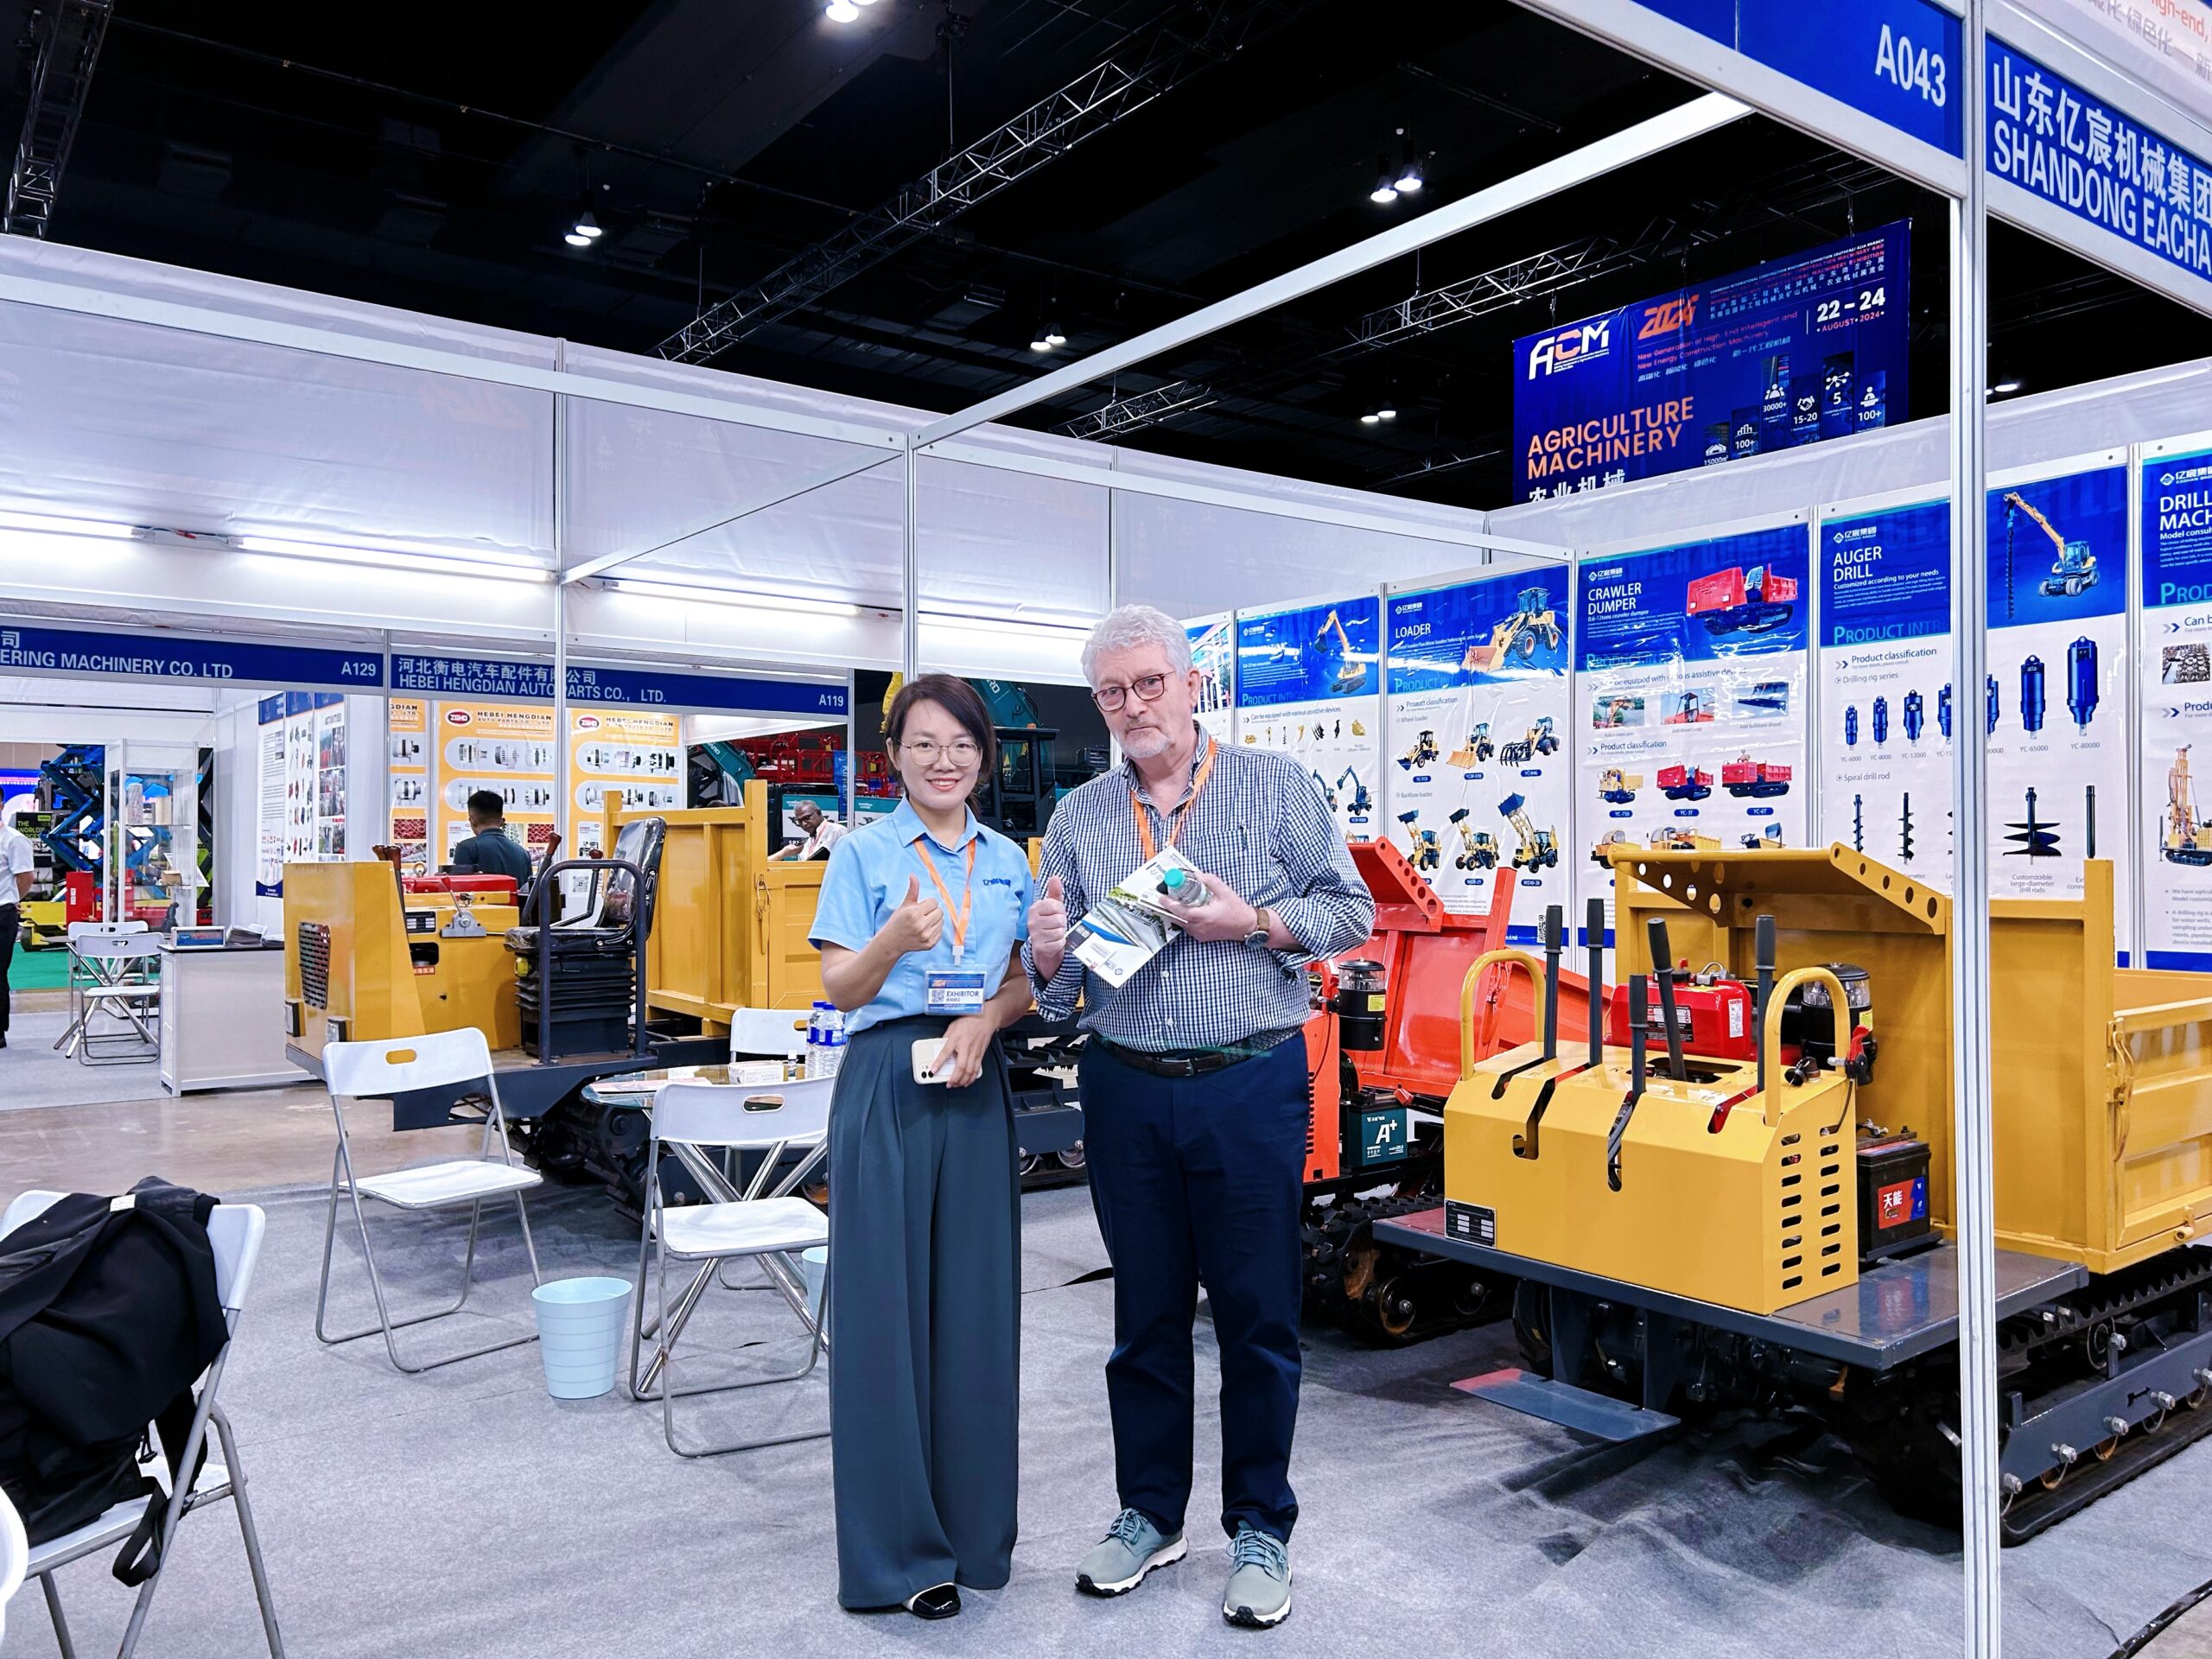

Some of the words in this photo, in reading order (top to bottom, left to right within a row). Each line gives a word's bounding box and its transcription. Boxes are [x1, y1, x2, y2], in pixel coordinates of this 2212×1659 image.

[1875, 23, 1946, 107] A043
[1993, 119, 2136, 238] SHANDONG
[1817, 300, 1840, 322] 22
[1859, 287, 1885, 311] 24
[1638, 293, 1700, 340] 2024
[1821, 317, 1854, 332] AUGUST
[1859, 311, 1880, 322] 2024
[1833, 391, 1841, 405] 5
[1793, 412, 1818, 425] 15-20
[1859, 410, 1882, 422] 100+
[1528, 396, 1694, 458] AGRICULTURE
[1528, 423, 1682, 480] MACHINERY
[1735, 439, 1756, 450] 100+
[2160, 531, 2184, 540] Model
[1834, 545, 1882, 567] AUGER
[1834, 563, 1873, 582] DRILL
[1834, 579, 1867, 590] Customized
[1868, 575, 1897, 586] according
[1905, 572, 1919, 581] your
[1920, 569, 1939, 578] needs
[1588, 582, 1642, 601] CRAWLER
[1587, 597, 1637, 615] DUMPER
[2184, 616, 2204, 626] Can
[1, 630, 20, 649] 司
[1395, 623, 1431, 639] LOADER
[1834, 623, 1904, 645] PRODUCT
[0, 649, 55, 667] ERING
[60, 652, 164, 675] MACHINERY
[168, 660, 198, 677] CO.
[202, 663, 233, 679] LTD
[1852, 654, 1883, 664] Product
[1885, 648, 1937, 661] classification
[341, 661, 377, 677] A129
[1842, 675, 1867, 684] Drilling
[1868, 674, 1878, 683] rig
[1878, 671, 1898, 680] series
[399, 674, 439, 690] HEBEI
[443, 677, 516, 694] HENGDIAN
[519, 683, 556, 696] AUTO
[566, 684, 601, 699] ARTS
[605, 687, 630, 702] CO.,
[640, 689, 666, 702] LTD.
[1624, 675, 1650, 686] equiped
[1651, 673, 1666, 683] with
[818, 694, 844, 707] A119
[1243, 693, 1276, 706] PRODUCT
[1600, 742, 1626, 751] Product
[1627, 740, 1667, 749] classification
[1843, 773, 1863, 782] Spiral
[1864, 772, 1878, 780] drill
[1883, 1190, 1903, 1209] 天能
